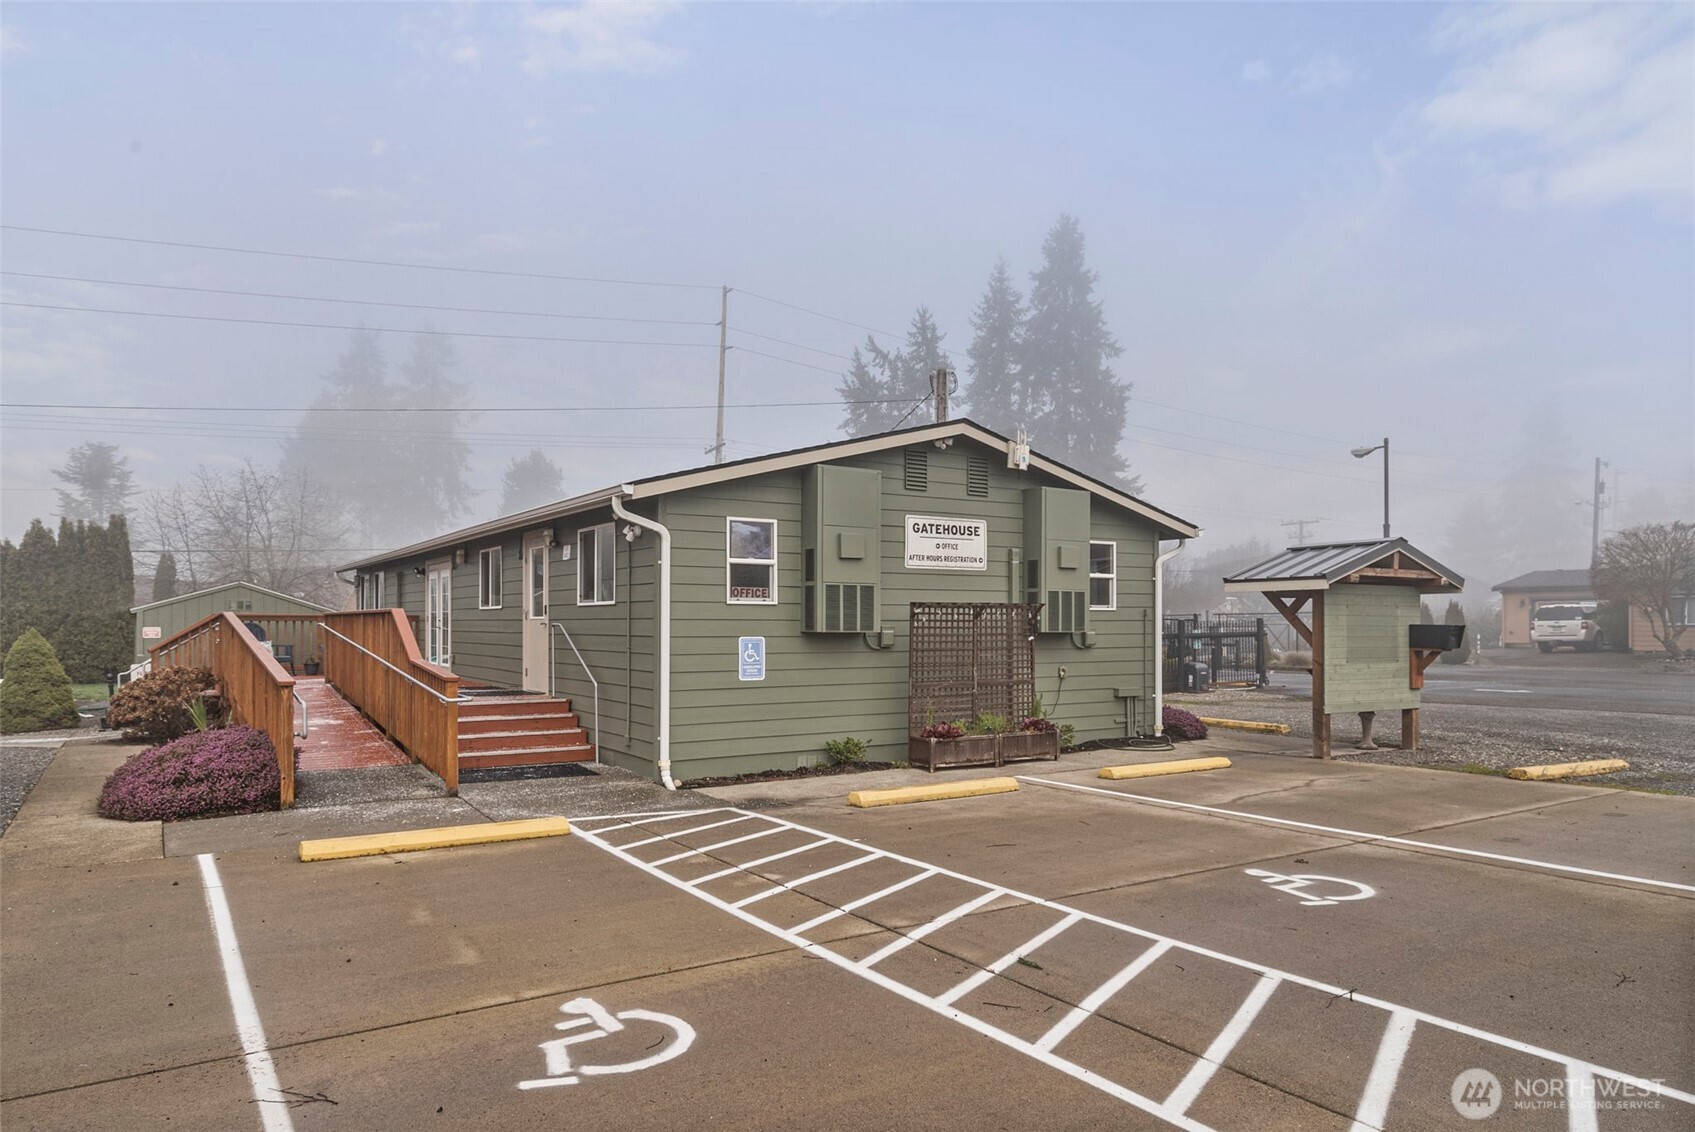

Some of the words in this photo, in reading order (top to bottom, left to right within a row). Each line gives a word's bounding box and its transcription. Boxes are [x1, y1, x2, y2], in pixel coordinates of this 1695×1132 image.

[912, 522, 980, 537] GATEHOUSE
[909, 554, 925, 562] AFTER
[732, 587, 768, 598] OFFICE
